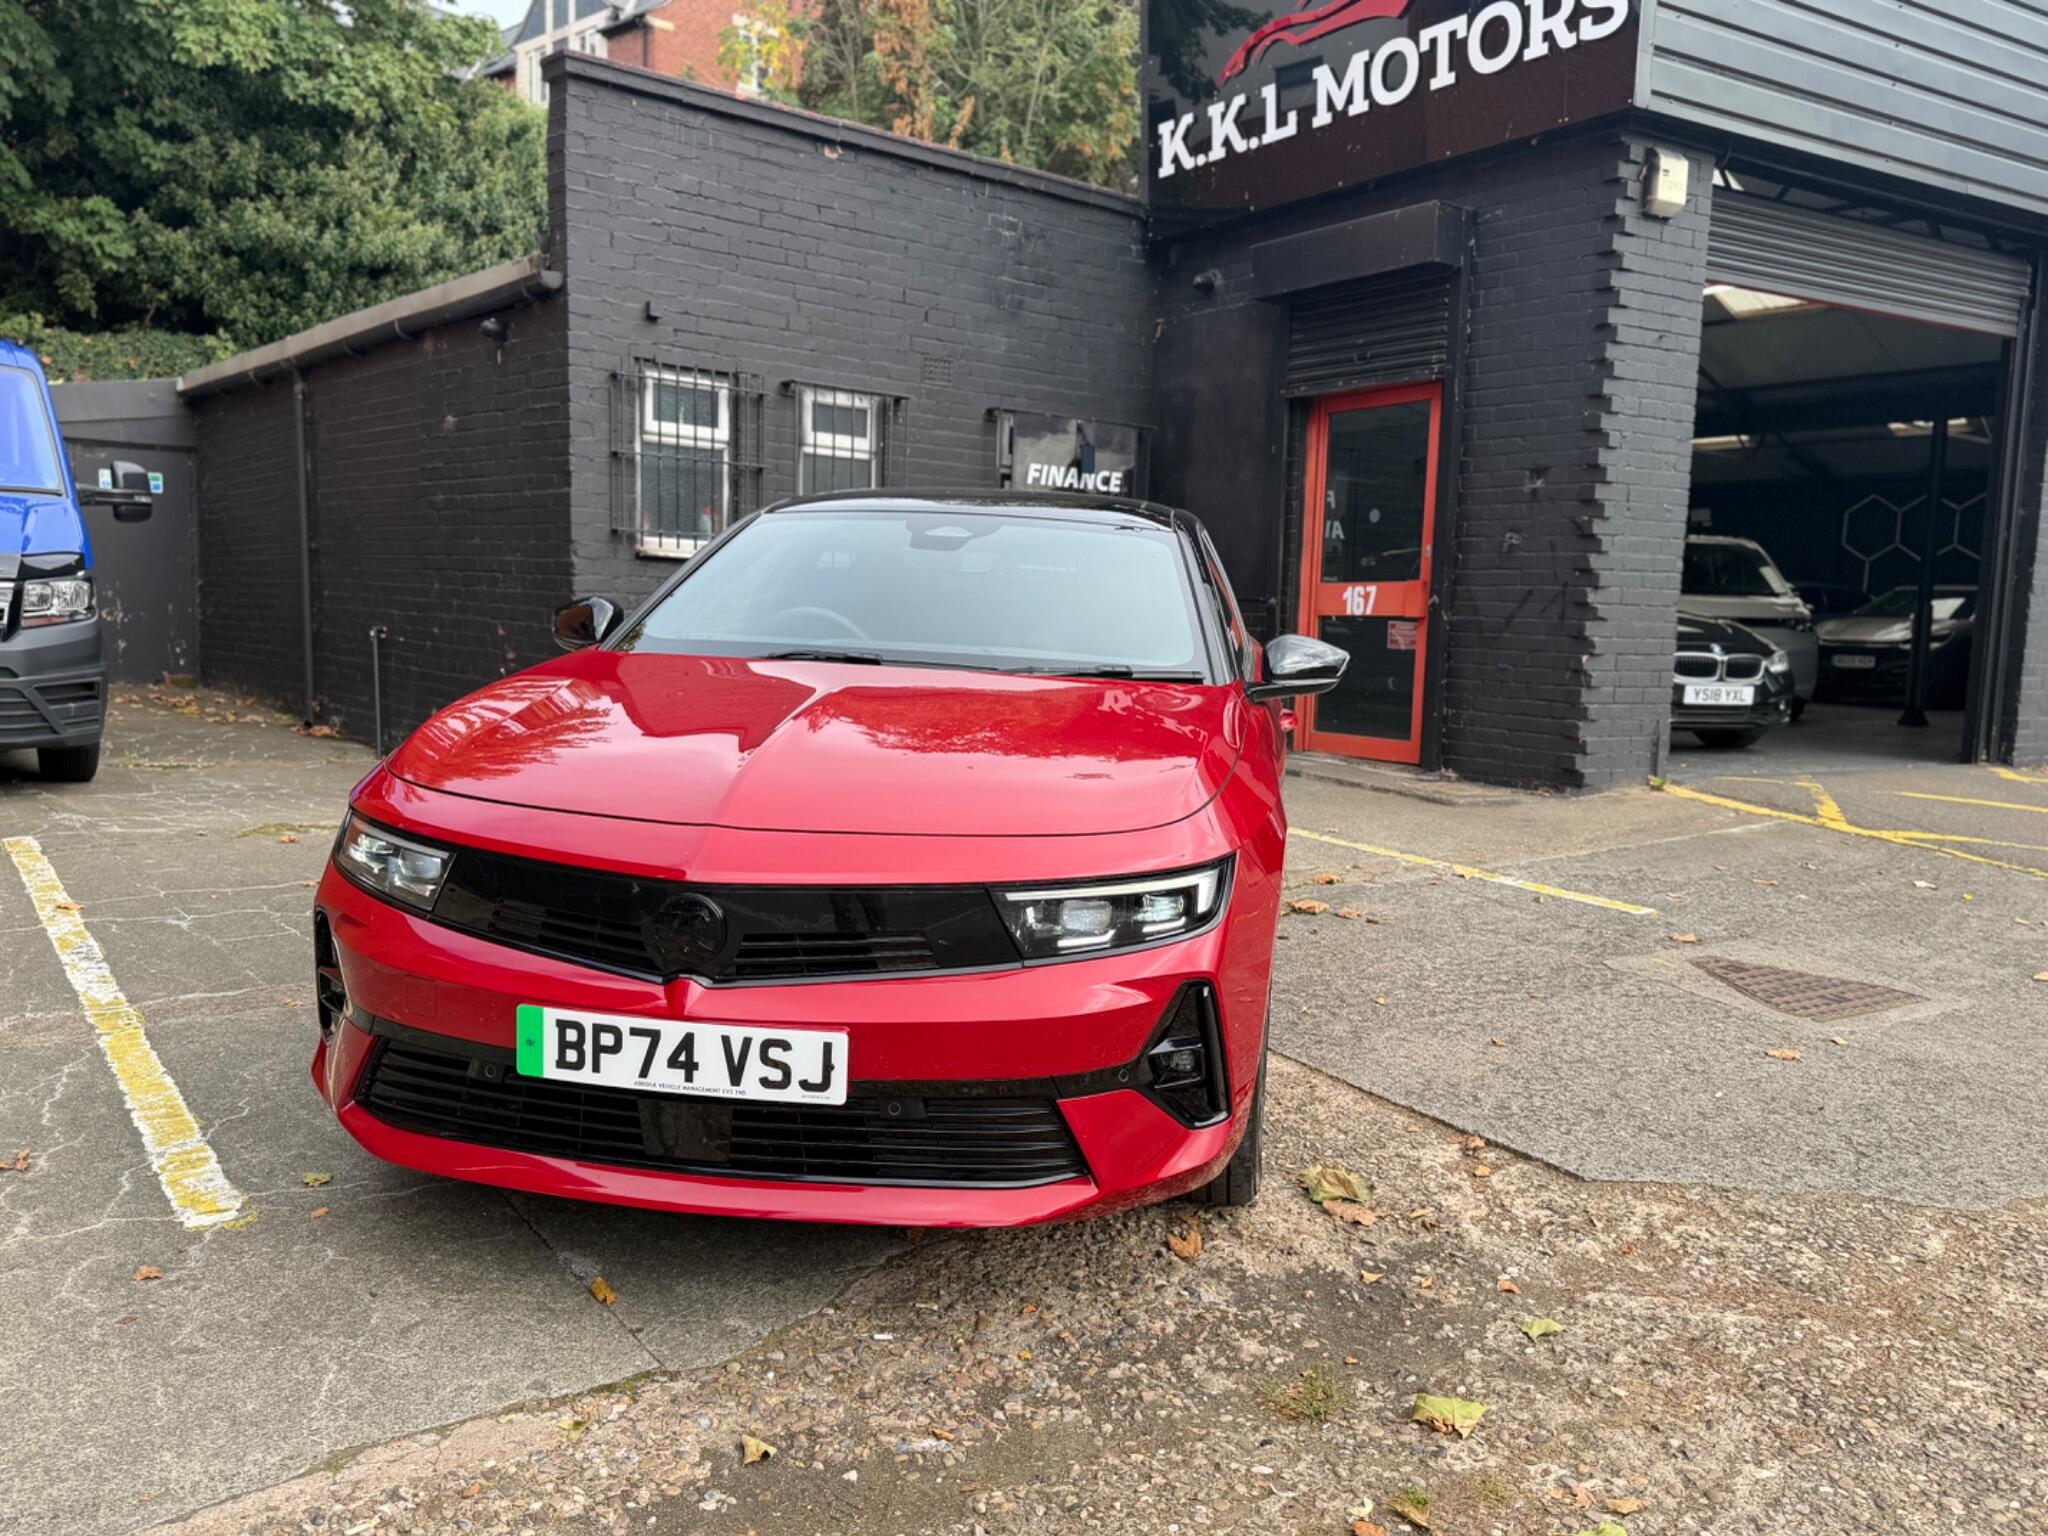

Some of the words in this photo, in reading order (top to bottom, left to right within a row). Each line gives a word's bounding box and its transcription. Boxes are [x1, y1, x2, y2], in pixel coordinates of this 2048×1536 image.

[1158, 83, 1298, 178] K.K.L
[1312, 0, 1629, 128] MOTORS
[1026, 462, 1124, 494] FINANCE
[1342, 585, 1377, 616] 167
[1694, 687, 1722, 702] YS18
[1725, 688, 1746, 703] YXL
[555, 1018, 699, 1083] BP74
[721, 1034, 835, 1093] VSJ
